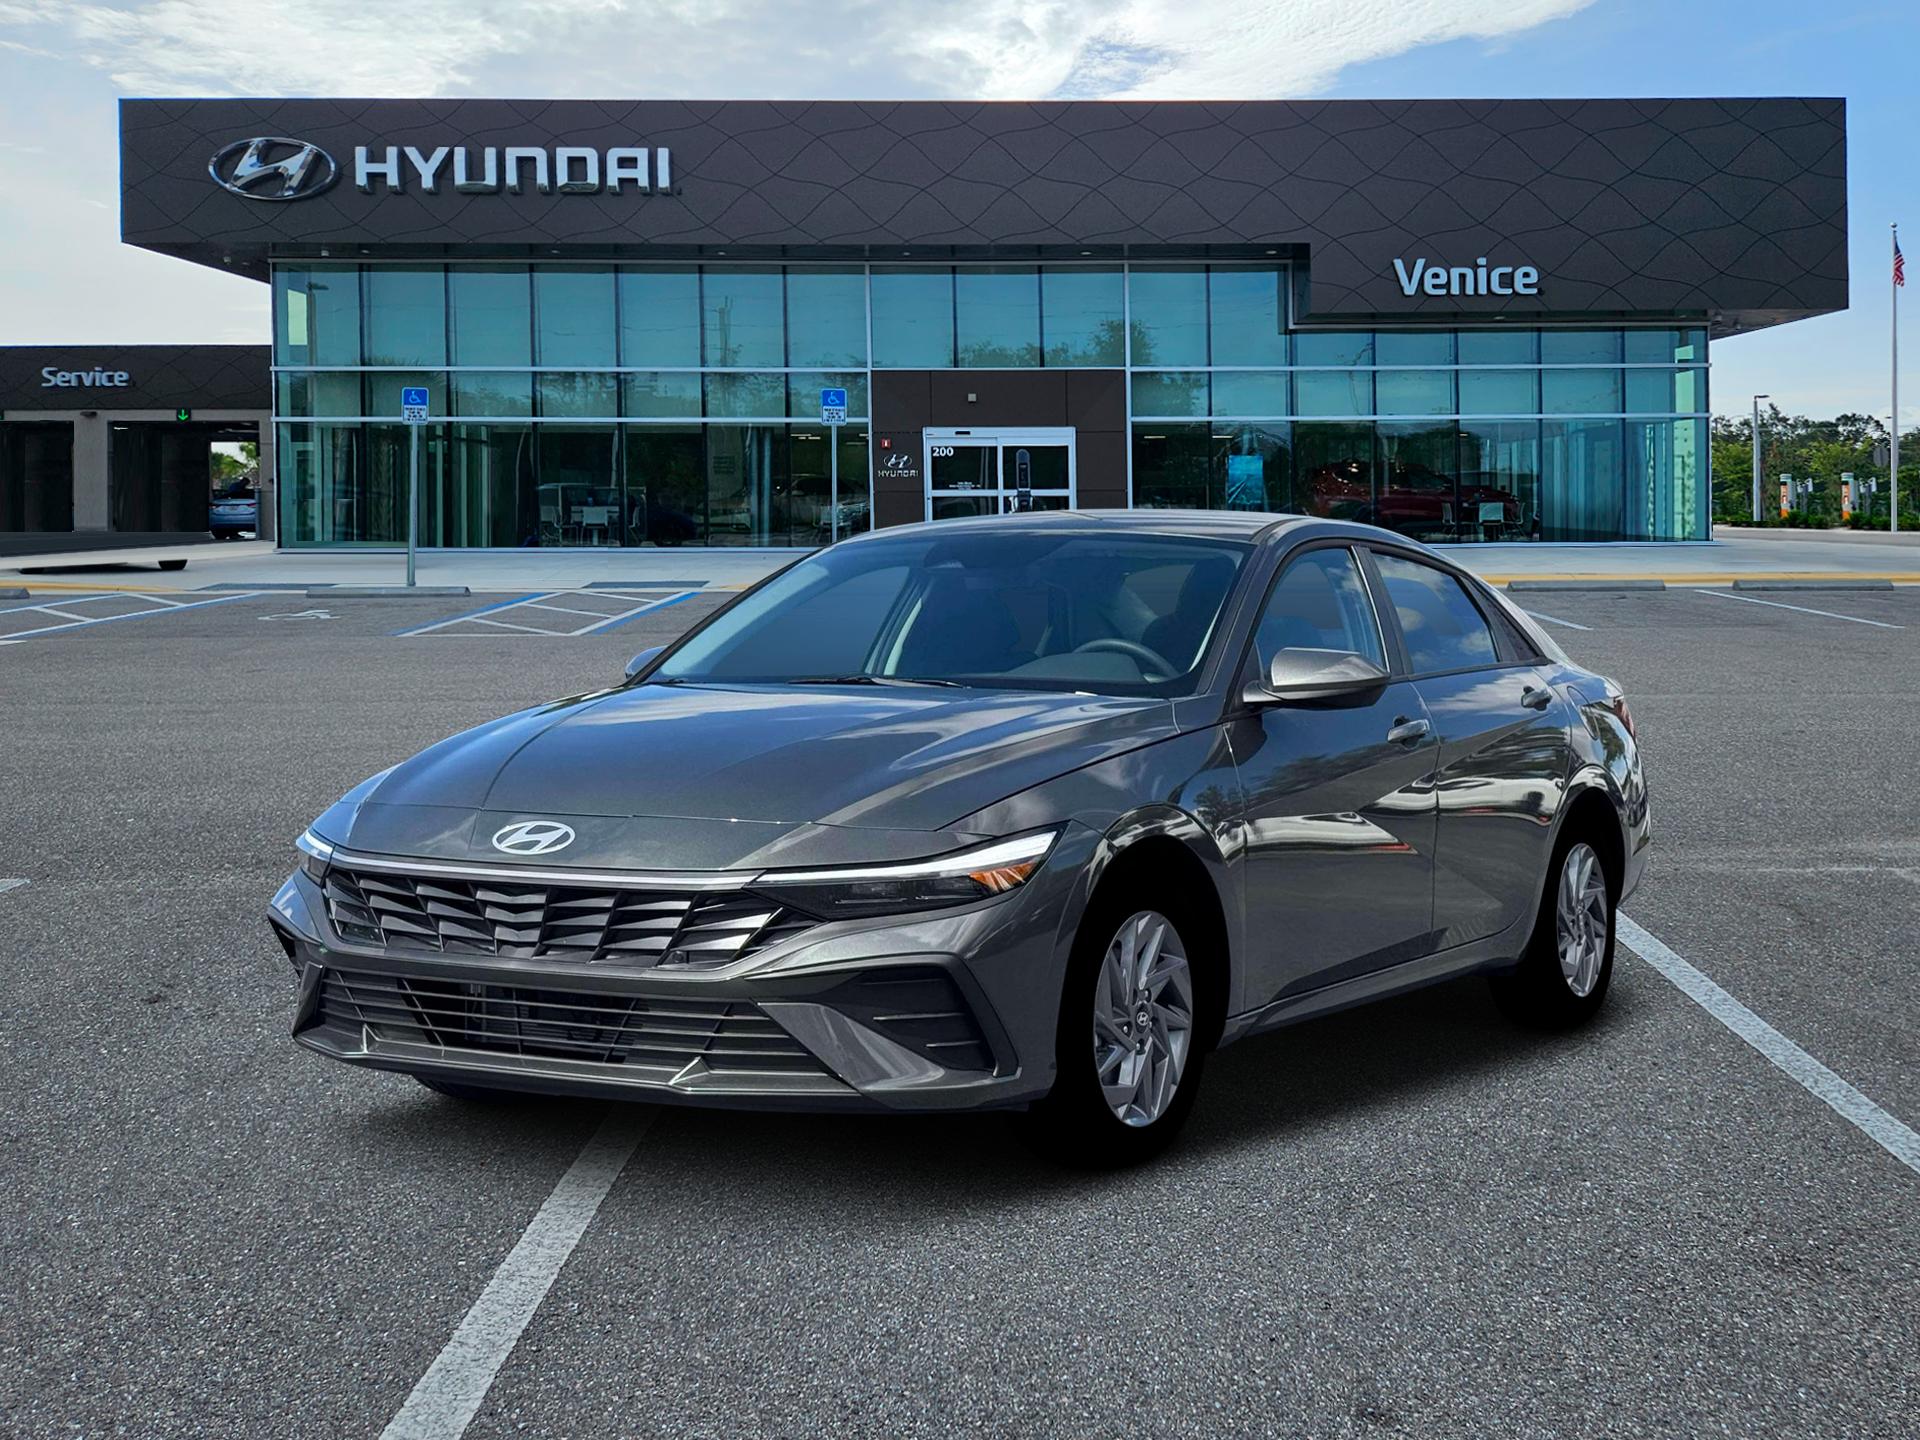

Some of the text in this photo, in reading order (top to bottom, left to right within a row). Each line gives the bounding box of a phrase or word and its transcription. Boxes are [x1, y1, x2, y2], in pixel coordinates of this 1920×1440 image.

[354, 146, 672, 194] HYUNDAI
[1393, 257, 1539, 296] Venice
[41, 366, 130, 387] Service
[932, 447, 954, 457] 200
[878, 469, 919, 478] HYUNDAI
